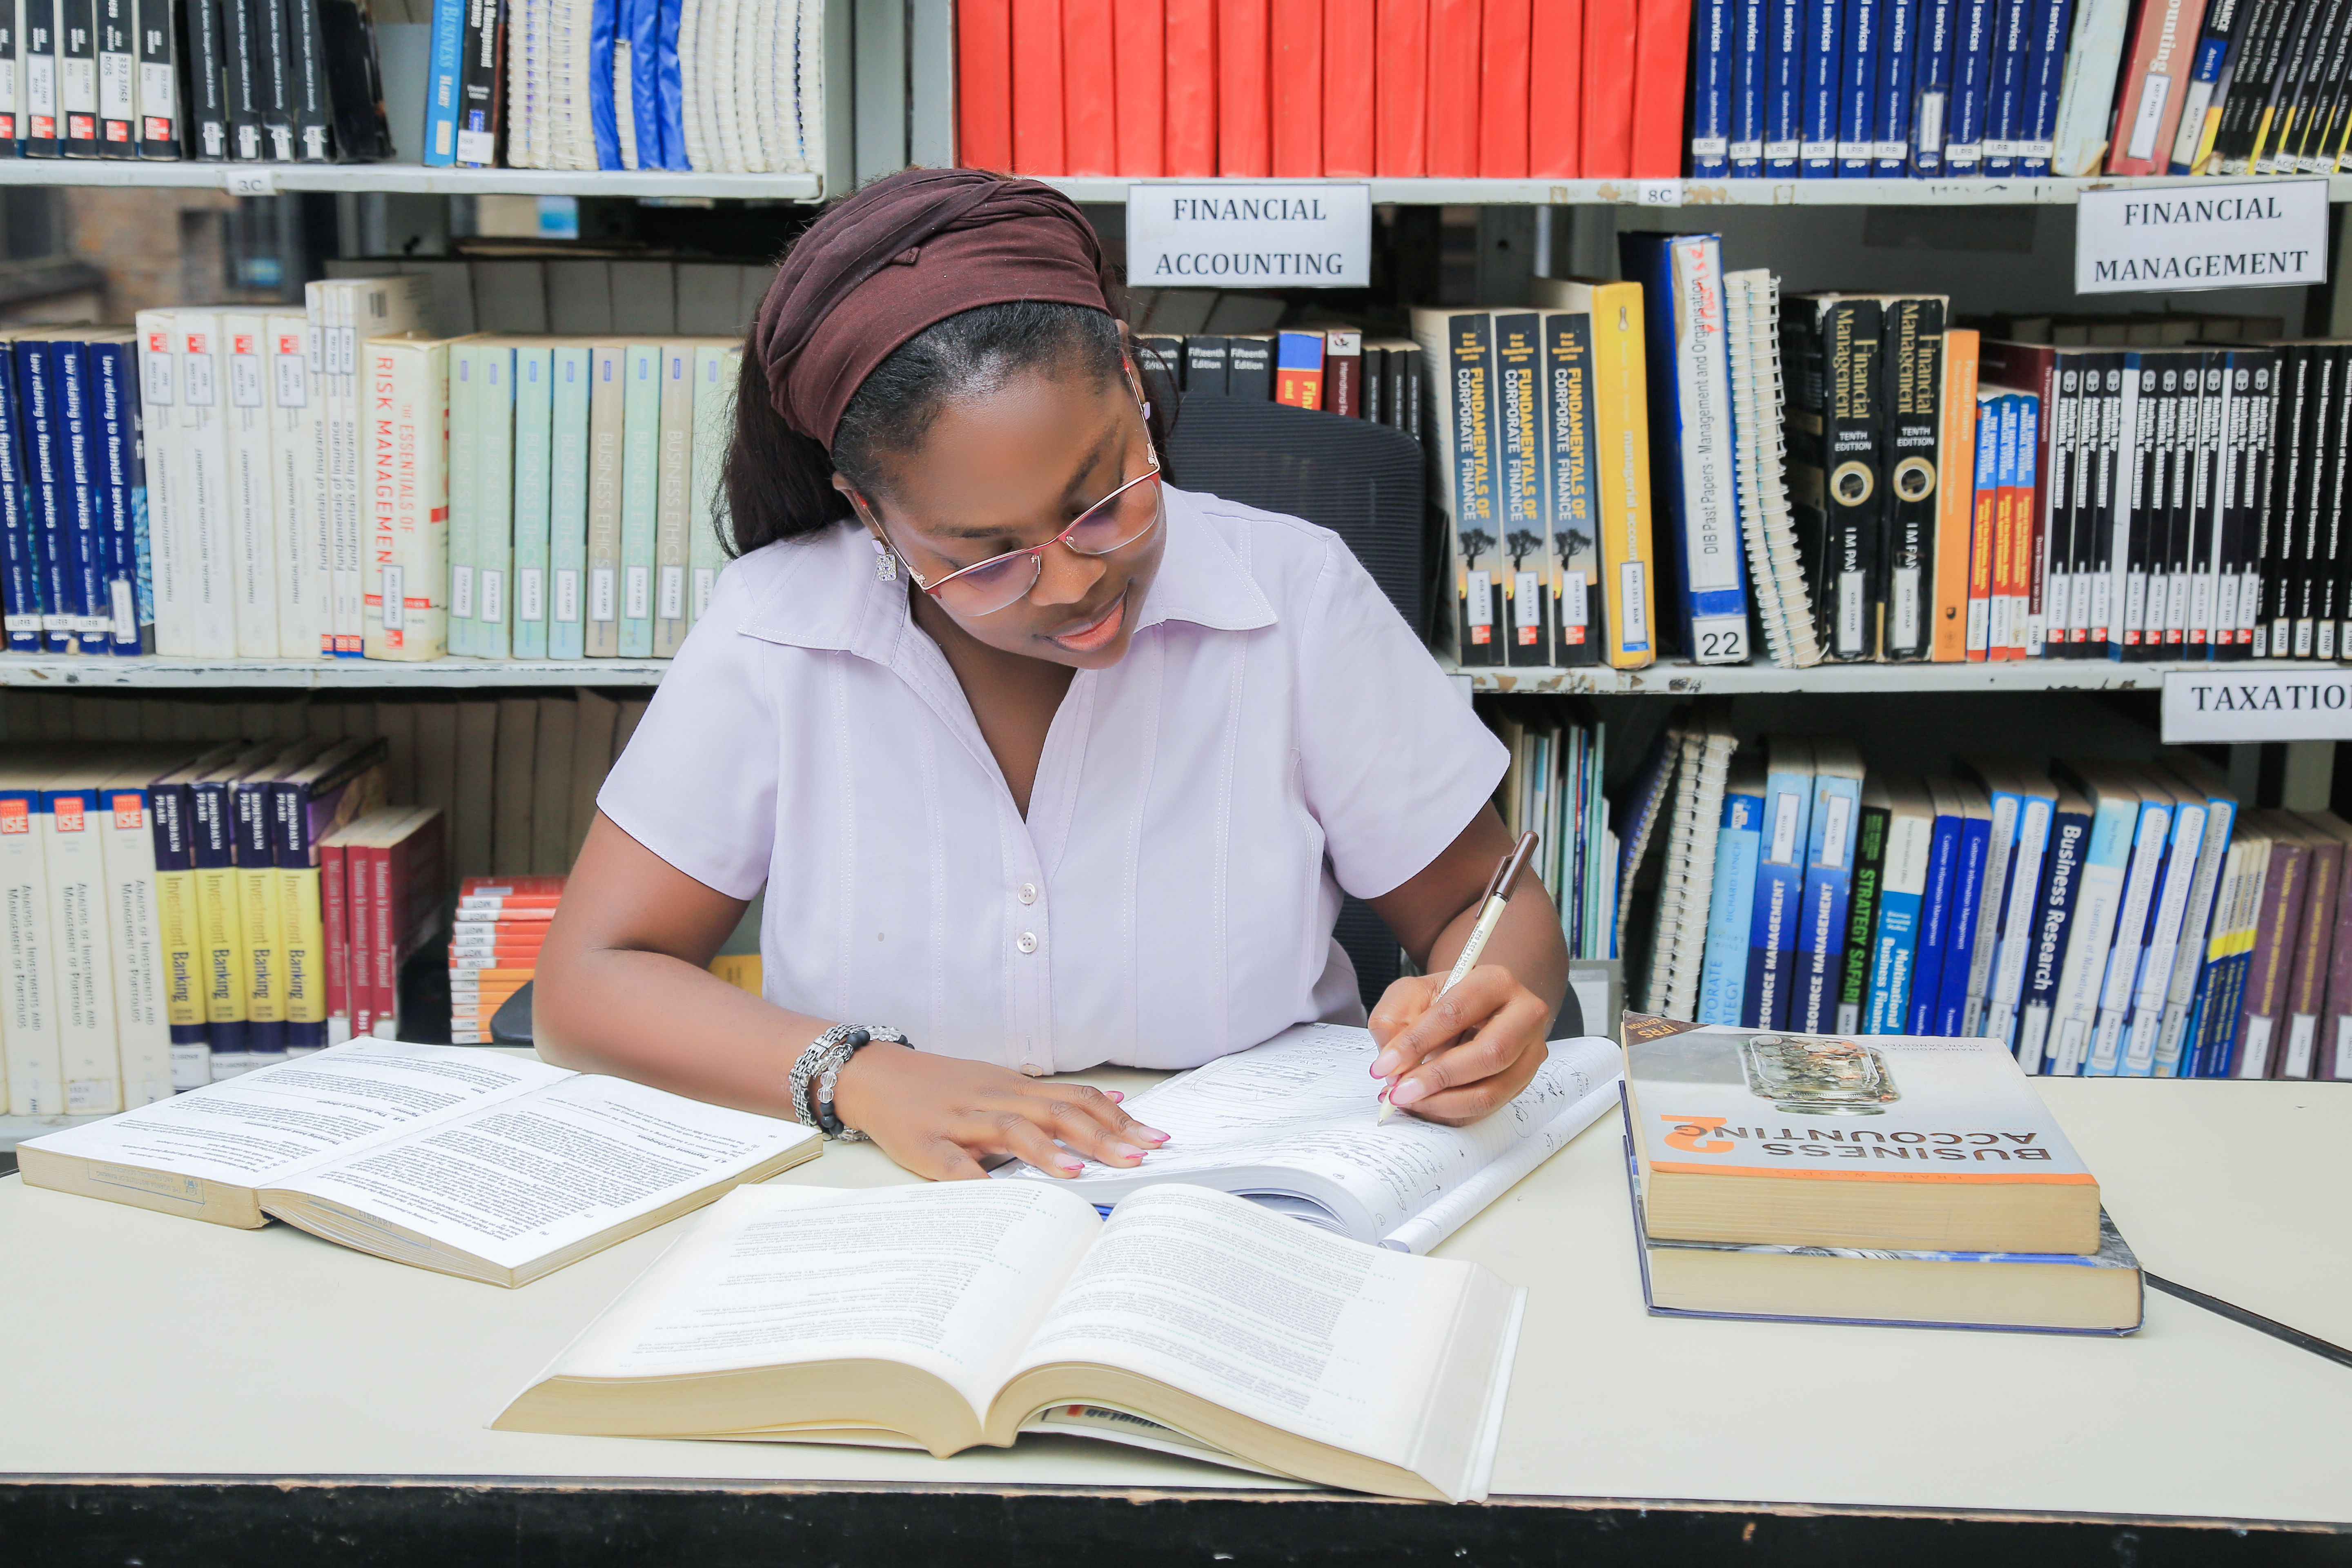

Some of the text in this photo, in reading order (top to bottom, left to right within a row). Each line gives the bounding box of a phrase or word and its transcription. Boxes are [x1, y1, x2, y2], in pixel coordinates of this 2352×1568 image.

[480, 6, 496, 68] Management
[1711, 6, 1723, 52] services
[1858, 6, 1871, 52] services
[2287, 38, 2306, 82] and Ratios
[238, 180, 263, 192] 3C
[1648, 189, 1672, 203] 8C
[1173, 199, 1327, 220] FINANCIAL
[2124, 197, 2282, 226] FINANCIAL
[1155, 253, 1343, 275] ACCOUNTING
[2095, 251, 2308, 282] MANAGEMENT
[1690, 279, 1708, 353] Organisation
[1231, 348, 1268, 359] Fifteenth
[1234, 359, 1263, 370] Edition
[1695, 356, 1708, 378] and
[1833, 309, 1855, 419] Management
[1898, 304, 1919, 414] Management
[1917, 334, 1942, 414] Financial
[1285, 379, 1294, 399] and
[1853, 339, 1878, 419] Financial
[1961, 360, 1975, 441] Personal Finance
[1696, 380, 1714, 454] Management
[1840, 432, 1868, 441] TENTH
[1902, 428, 1931, 437] TENTH
[2066, 398, 2078, 452] Analysis for
[102, 355, 125, 531] law relating to financial services
[1458, 368, 1477, 521] CORPORATE FINANCE
[1471, 367, 1490, 519] FUNDAMENTALS OF
[1555, 368, 1572, 521] CORPORATE FINANCE
[1568, 368, 1586, 519] FUNDAMENTALS OF
[1835, 441, 1872, 451] EDITION
[1897, 437, 1934, 447] EDITION
[2017, 404, 2029, 482] FINANCIAL SYSTEMS
[2025, 414, 2036, 472] THE UGANDAN
[2054, 397, 2069, 509] FINANCIAL MANAGEMENT
[2306, 360, 2332, 559] Financial Management of Multinational Corporations
[375, 357, 393, 572] RISK MANAGEMEN
[399, 425, 414, 510] ESSENTIALS
[1623, 430, 1637, 507] managerial
[1699, 464, 1715, 503] Papers
[345, 421, 358, 571] Fundamentals of Insurance
[595, 433, 612, 568] BUSINESS ETHICS
[664, 431, 683, 566] BUSINESS ETHICS
[1702, 506, 1717, 530] Past
[157, 447, 173, 602] FINANCIAL INSTITUTIONS MANAGEMENT
[400, 516, 414, 535] OF
[1704, 534, 1718, 555] DIB
[1702, 631, 1739, 656] 22
[2323, 629, 2331, 651] FINM
[2191, 686, 2352, 711] TAXATIO
[116, 812, 141, 829] ISE
[155, 795, 167, 825] PEARL
[166, 795, 180, 852] ROSENBAUM
[135, 881, 146, 922] ANALYSIS
[376, 862, 389, 897] Valuation
[1726, 842, 1741, 923] RICHARD LYNCH
[1929, 834, 1952, 946] Customer Information Management
[2025, 871, 2035, 891] AND
[378, 908, 390, 950] Investment
[1766, 879, 1784, 970] MANAGEMENT
[2033, 825, 2082, 991] Business Research
[122, 884, 135, 949] MANAGEMENT
[129, 970, 140, 1022] PORTFOLIOS
[165, 877, 189, 1002] Investment Banking
[1461, 929, 1483, 966] 0414 233 628
[1844, 869, 1875, 1003] STRATEGY SAFARI
[2074, 898, 2106, 1000] Essentials of Marketing
[142, 942, 153, 1002] INVESTMENTS
[376, 952, 391, 987] Appraisal
[1870, 936, 1895, 1034] Business Finance
[1886, 948, 1909, 1028] Multinational
[145, 1007, 154, 1025] AND
[1626, 1018, 1662, 1030] EDITION
[1637, 1024, 1678, 1038] IFRS
[357, 1105, 374, 1114] form
[1659, 1114, 1735, 1154] 2
[1674, 1125, 2037, 1145] ACCOUNTING
[1761, 1144, 2052, 1162] BUSINESS
[151, 1182, 171, 1192] UGANDA
[1771, 1170, 1867, 1178] WOOD'S
[359, 1209, 392, 1229] LIBRARY
